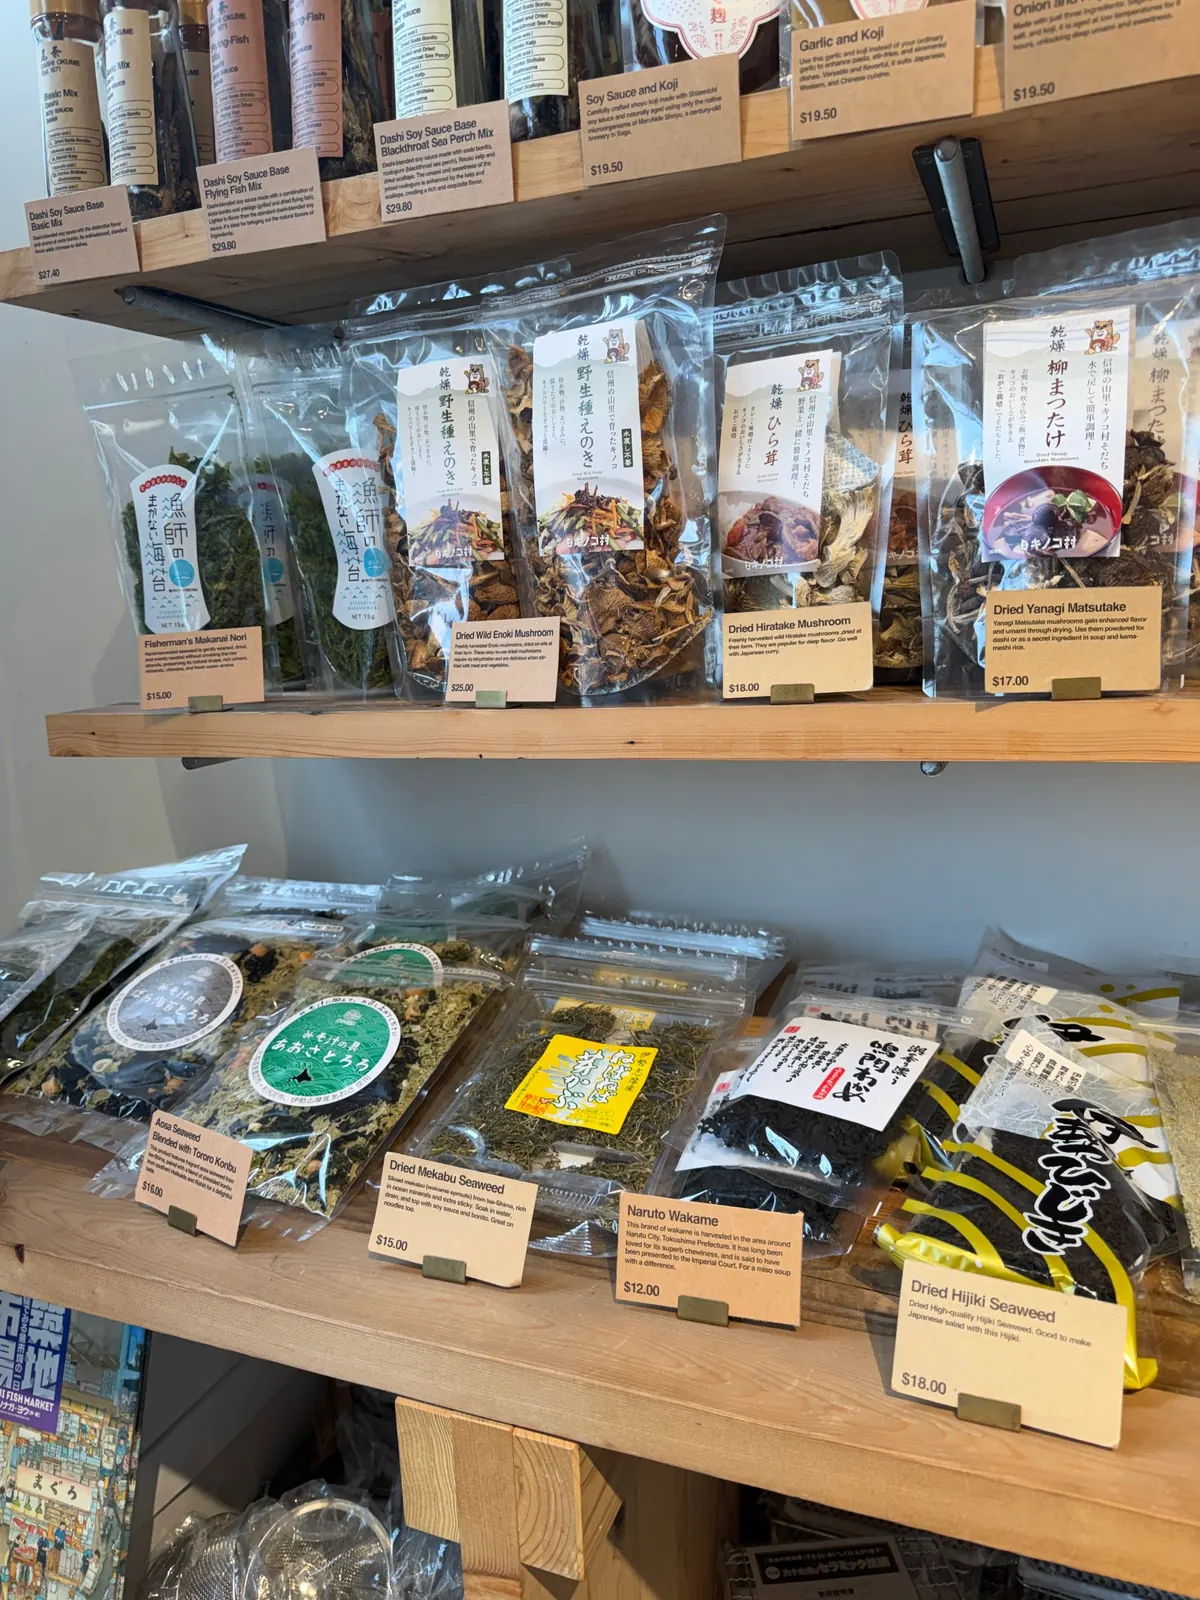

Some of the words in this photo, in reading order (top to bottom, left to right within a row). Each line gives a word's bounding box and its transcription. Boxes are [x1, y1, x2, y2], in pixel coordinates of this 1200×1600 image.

[1013, 0, 1053, 16] Onion
[799, 36, 834, 52] Garlic
[835, 30, 858, 46] and
[861, 26, 884, 41] Koji
[56, 59, 80, 67] OKUME
[44, 91, 61, 101] Basic
[62, 89, 79, 98] Mix
[586, 94, 605, 106] Soy
[606, 88, 637, 102] Sauce
[638, 82, 657, 96] and
[659, 77, 678, 92] Koji
[1013, 81, 1055, 102] $19.50
[799, 107, 837, 124] $19.50
[379, 131, 405, 145] Dashi
[405, 129, 423, 144] Soy
[424, 124, 452, 137] Sauce
[453, 120, 477, 131] Base
[380, 139, 430, 157] Blackthroat
[431, 137, 448, 148] Sea
[449, 131, 476, 144] Perch
[477, 128, 494, 139] Mix
[202, 175, 226, 188] Dashi
[226, 174, 243, 188] Soy
[242, 169, 268, 181] Sauce
[268, 165, 290, 177] Base
[590, 160, 623, 176] $19.50
[204, 188, 229, 201] Flying
[229, 183, 247, 195] Fish
[247, 181, 262, 192] Mix
[29, 209, 49, 221] Dashi
[48, 208, 63, 218] Soy
[63, 204, 85, 215] Sauce
[85, 200, 104, 211] Base
[385, 200, 413, 215] $29.80
[30, 220, 50, 231] Basic
[50, 216, 63, 228] Mix
[211, 240, 237, 253] $29.80
[38, 268, 60, 280] $27.40
[577, 334, 589, 361] 乾燥
[1049, 325, 1067, 353] 乾燥
[439, 366, 451, 391] 乾燥
[770, 383, 783, 410] 乾燥
[1046, 359, 1068, 449] 柳まつたけ
[1085, 360, 1097, 450] 水で戻して簡単調理！
[576, 364, 594, 468] 野生種えのき
[606, 369, 618, 470] 信州の山里で育ったキノコ
[1099, 357, 1113, 470] 信州の山里・キノコ村そだち
[438, 394, 456, 486] 野生種えのき
[467, 400, 477, 486] 信州の山里で育ったキノコ
[764, 415, 781, 466] ひら茸
[802, 395, 817, 498] 信州の山里・キノコ村そだち
[898, 420, 913, 464] ひら茸
[1030, 535, 1076, 550] キノコ村
[993, 604, 1024, 615] Dried
[1026, 602, 1065, 616] Yanagi
[1067, 601, 1127, 613] Matsutake
[455, 631, 475, 640] Dried
[475, 630, 492, 639] Wild
[492, 629, 513, 639] Enoki
[514, 628, 554, 638] Mushroom
[728, 623, 754, 634] Dried
[755, 621, 796, 632] Hiratake
[797, 617, 851, 628] Mushroom
[144, 637, 194, 648] Fisherman's
[194, 634, 228, 644] Makanai
[229, 633, 247, 642] Nori
[450, 683, 474, 692] $25.00
[728, 682, 760, 693] $18.00
[992, 675, 1029, 687] $17.00
[146, 690, 172, 701] $15.00
[302, 1030, 361, 1052] みそ汁の具
[271, 1038, 370, 1072] あおさとろろ
[541, 1049, 605, 1110] 芽かぶ
[587, 1049, 635, 1104] ねばねば
[832, 1040, 899, 1103] 鳴門わかめ
[154, 1117, 172, 1131] Aosa
[172, 1123, 202, 1143] Seaweed
[152, 1130, 179, 1149] Blended
[178, 1143, 192, 1155] with
[193, 1146, 214, 1164] Tororo
[214, 1156, 237, 1174] Konbu
[141, 1180, 163, 1198] $16.00
[389, 1159, 416, 1175] Dried
[417, 1165, 457, 1184] Mekabu
[458, 1174, 505, 1195] Seaweed
[627, 1204, 666, 1220] Naruto
[668, 1209, 719, 1227] Wakame
[375, 1234, 408, 1252] $15.00
[625, 1230, 647, 1239] Naruto
[647, 1232, 661, 1242] City,
[662, 1234, 696, 1246] Tokushima
[696, 1239, 731, 1250] Prefecture.
[731, 1243, 736, 1251] It
[737, 1244, 750, 1252] has
[750, 1246, 766, 1256] long
[766, 1248, 783, 1256] been
[626, 1220, 640, 1229] This
[640, 1222, 659, 1231] brand
[666, 1227, 693, 1236] wakame
[700, 1230, 732, 1240] harvested
[740, 1235, 751, 1243] the
[767, 1239, 791, 1248] around
[623, 1280, 660, 1297] $12.00
[911, 1279, 948, 1299] Dried
[951, 1288, 986, 1308] Hijiki
[989, 1297, 1056, 1323] Seaweed
[907, 1310, 944, 1324] Japanese
[944, 1319, 965, 1330] salad
[966, 1324, 983, 1334] with
[984, 1328, 998, 1337] this
[999, 1331, 1020, 1343] Hijiki.
[908, 1298, 929, 1310] Dried
[930, 1303, 975, 1322] High-quality
[976, 1314, 995, 1325] Hijiki
[996, 1319, 1034, 1334] Seaweed.
[1035, 1328, 1058, 1340] Good
[1059, 1334, 1068, 1342] to
[1068, 1337, 1092, 1347] make
[901, 1371, 947, 1395] $18.00
[6, 1391, 24, 1404] FISH
[24, 1395, 54, 1412] MARKET
[32, 1473, 78, 1500] まぐろ
